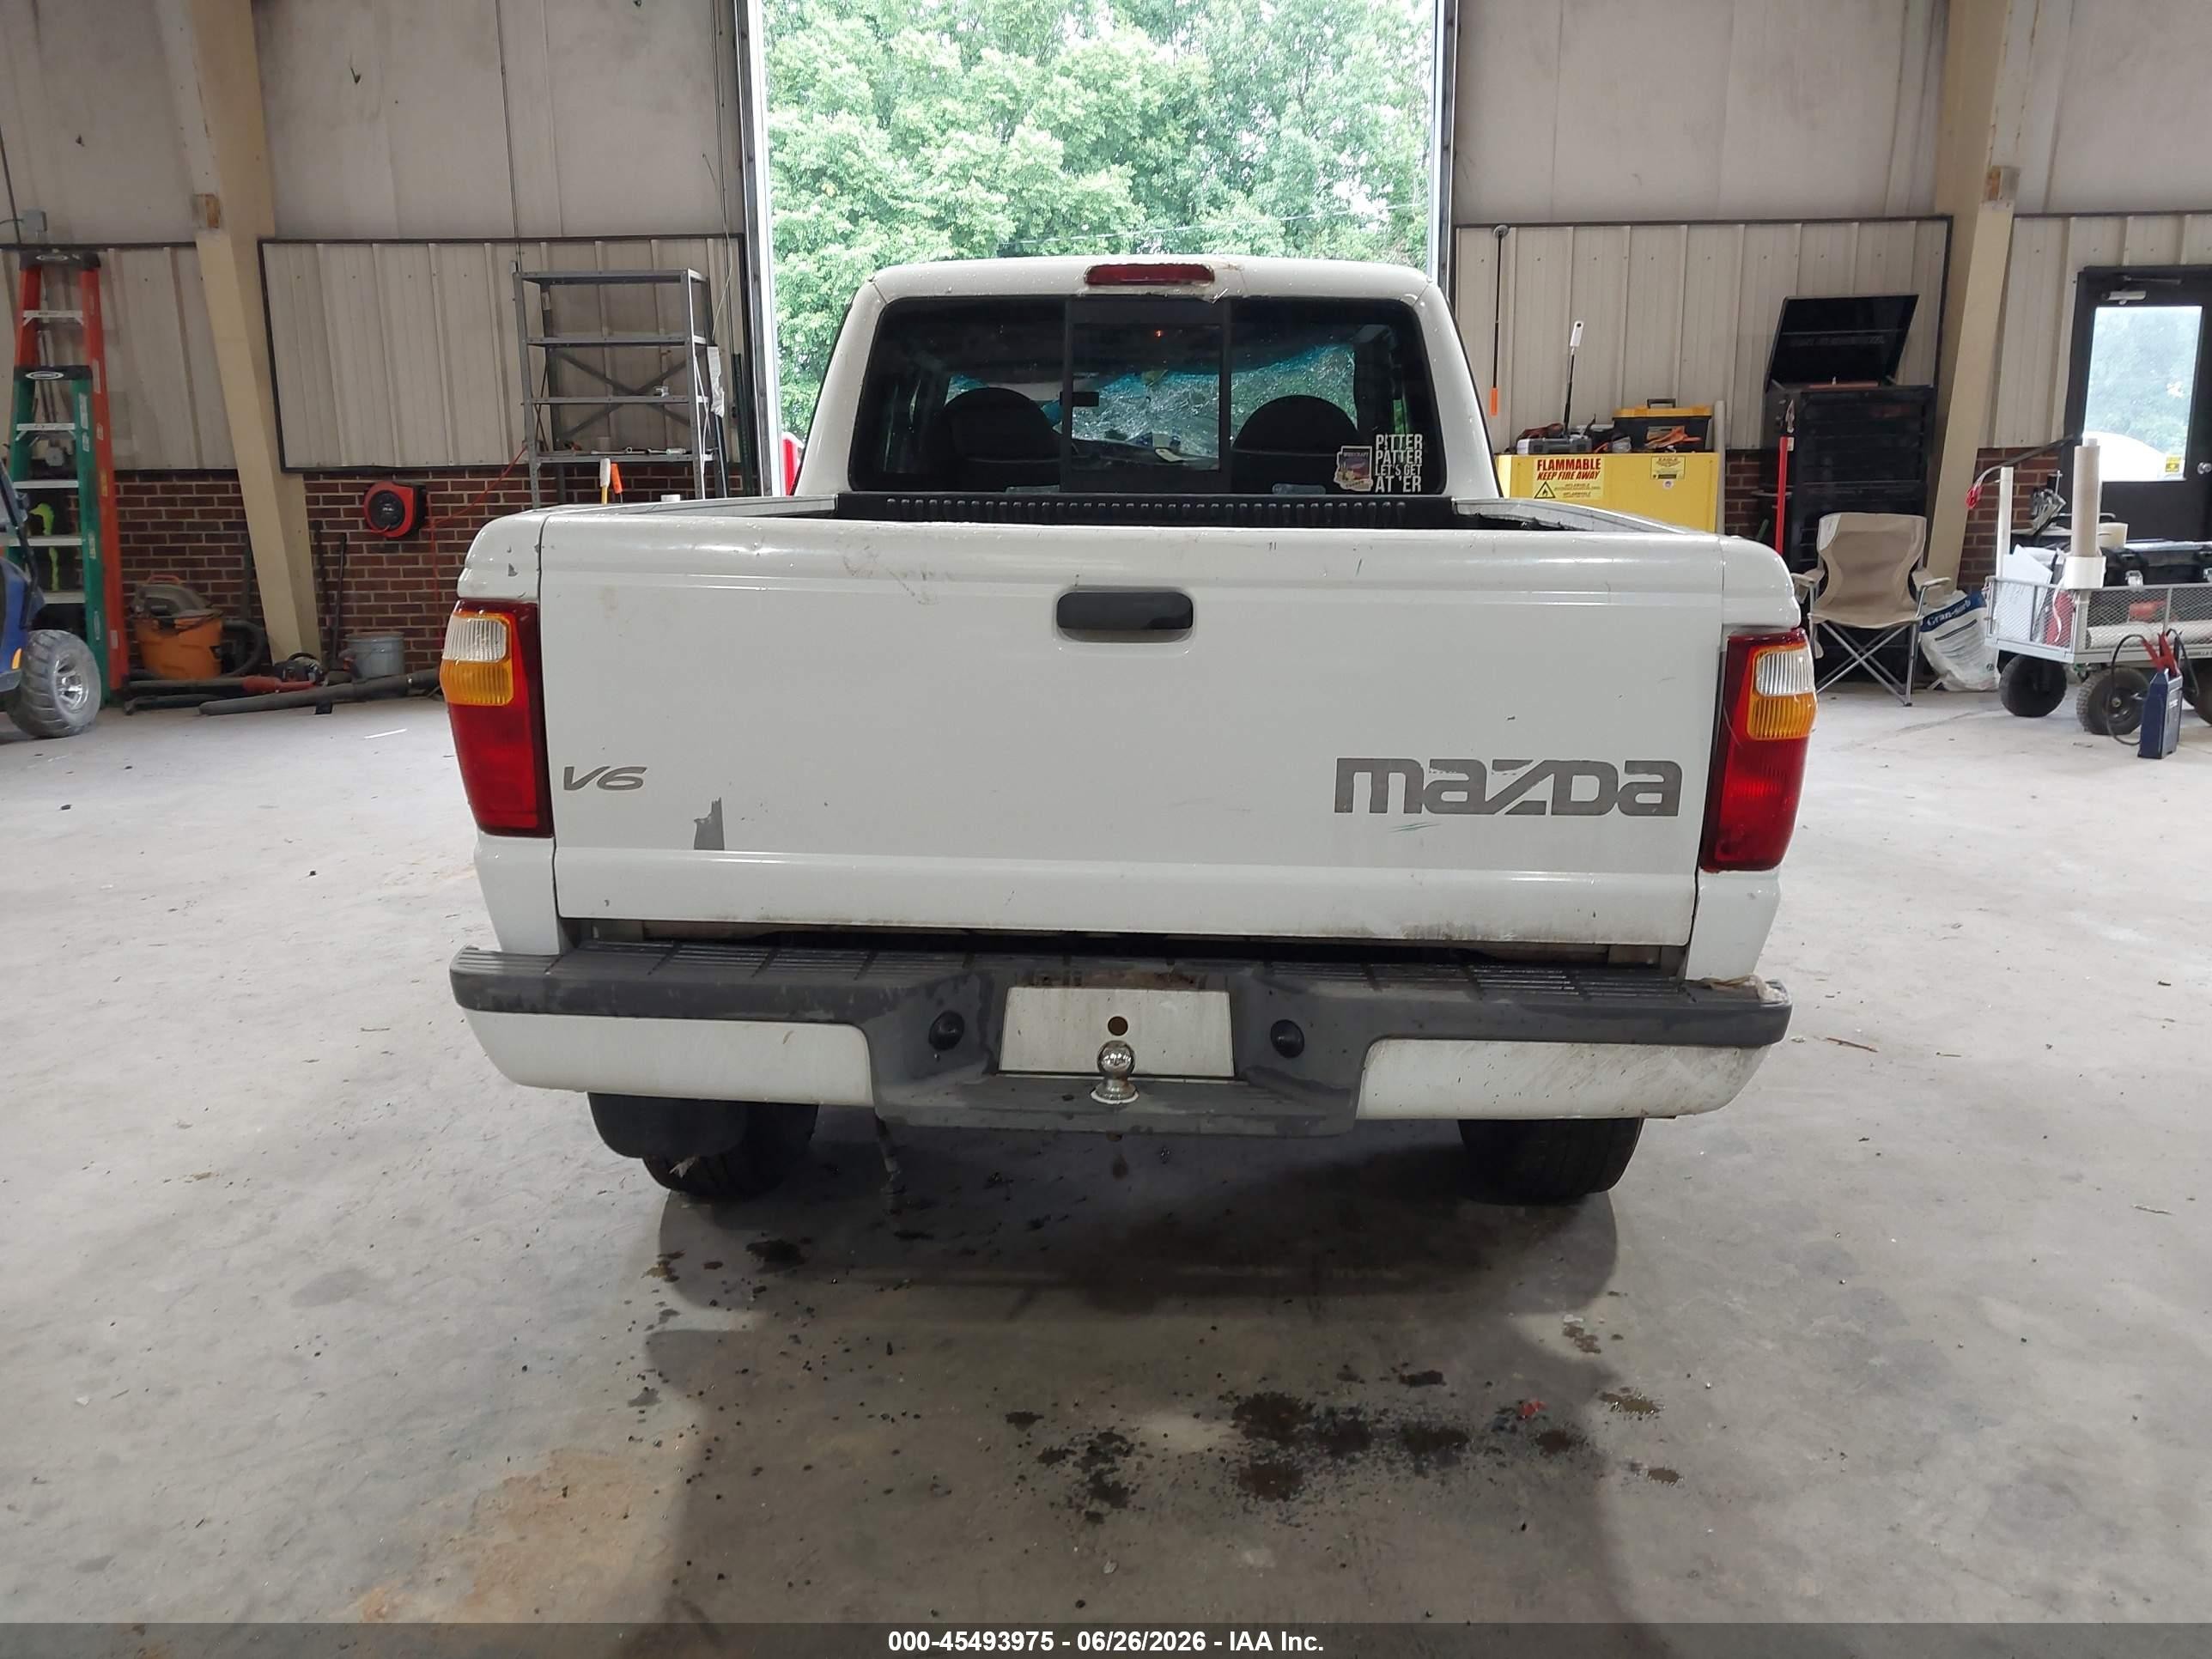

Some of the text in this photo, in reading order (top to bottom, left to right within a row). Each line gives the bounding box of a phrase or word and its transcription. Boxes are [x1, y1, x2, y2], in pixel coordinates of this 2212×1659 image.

[1376, 433, 1423, 450] PITTER
[1376, 449, 1423, 465] PATTER
[1537, 459, 1601, 471] FLAMMABLE
[1375, 464, 1422, 476] LET'S GET
[1537, 471, 1601, 480] KEEP FIRE AWAY
[1375, 475, 1395, 492] AT
[1398, 475, 1422, 492] 'ER
[562, 765, 648, 792] V6
